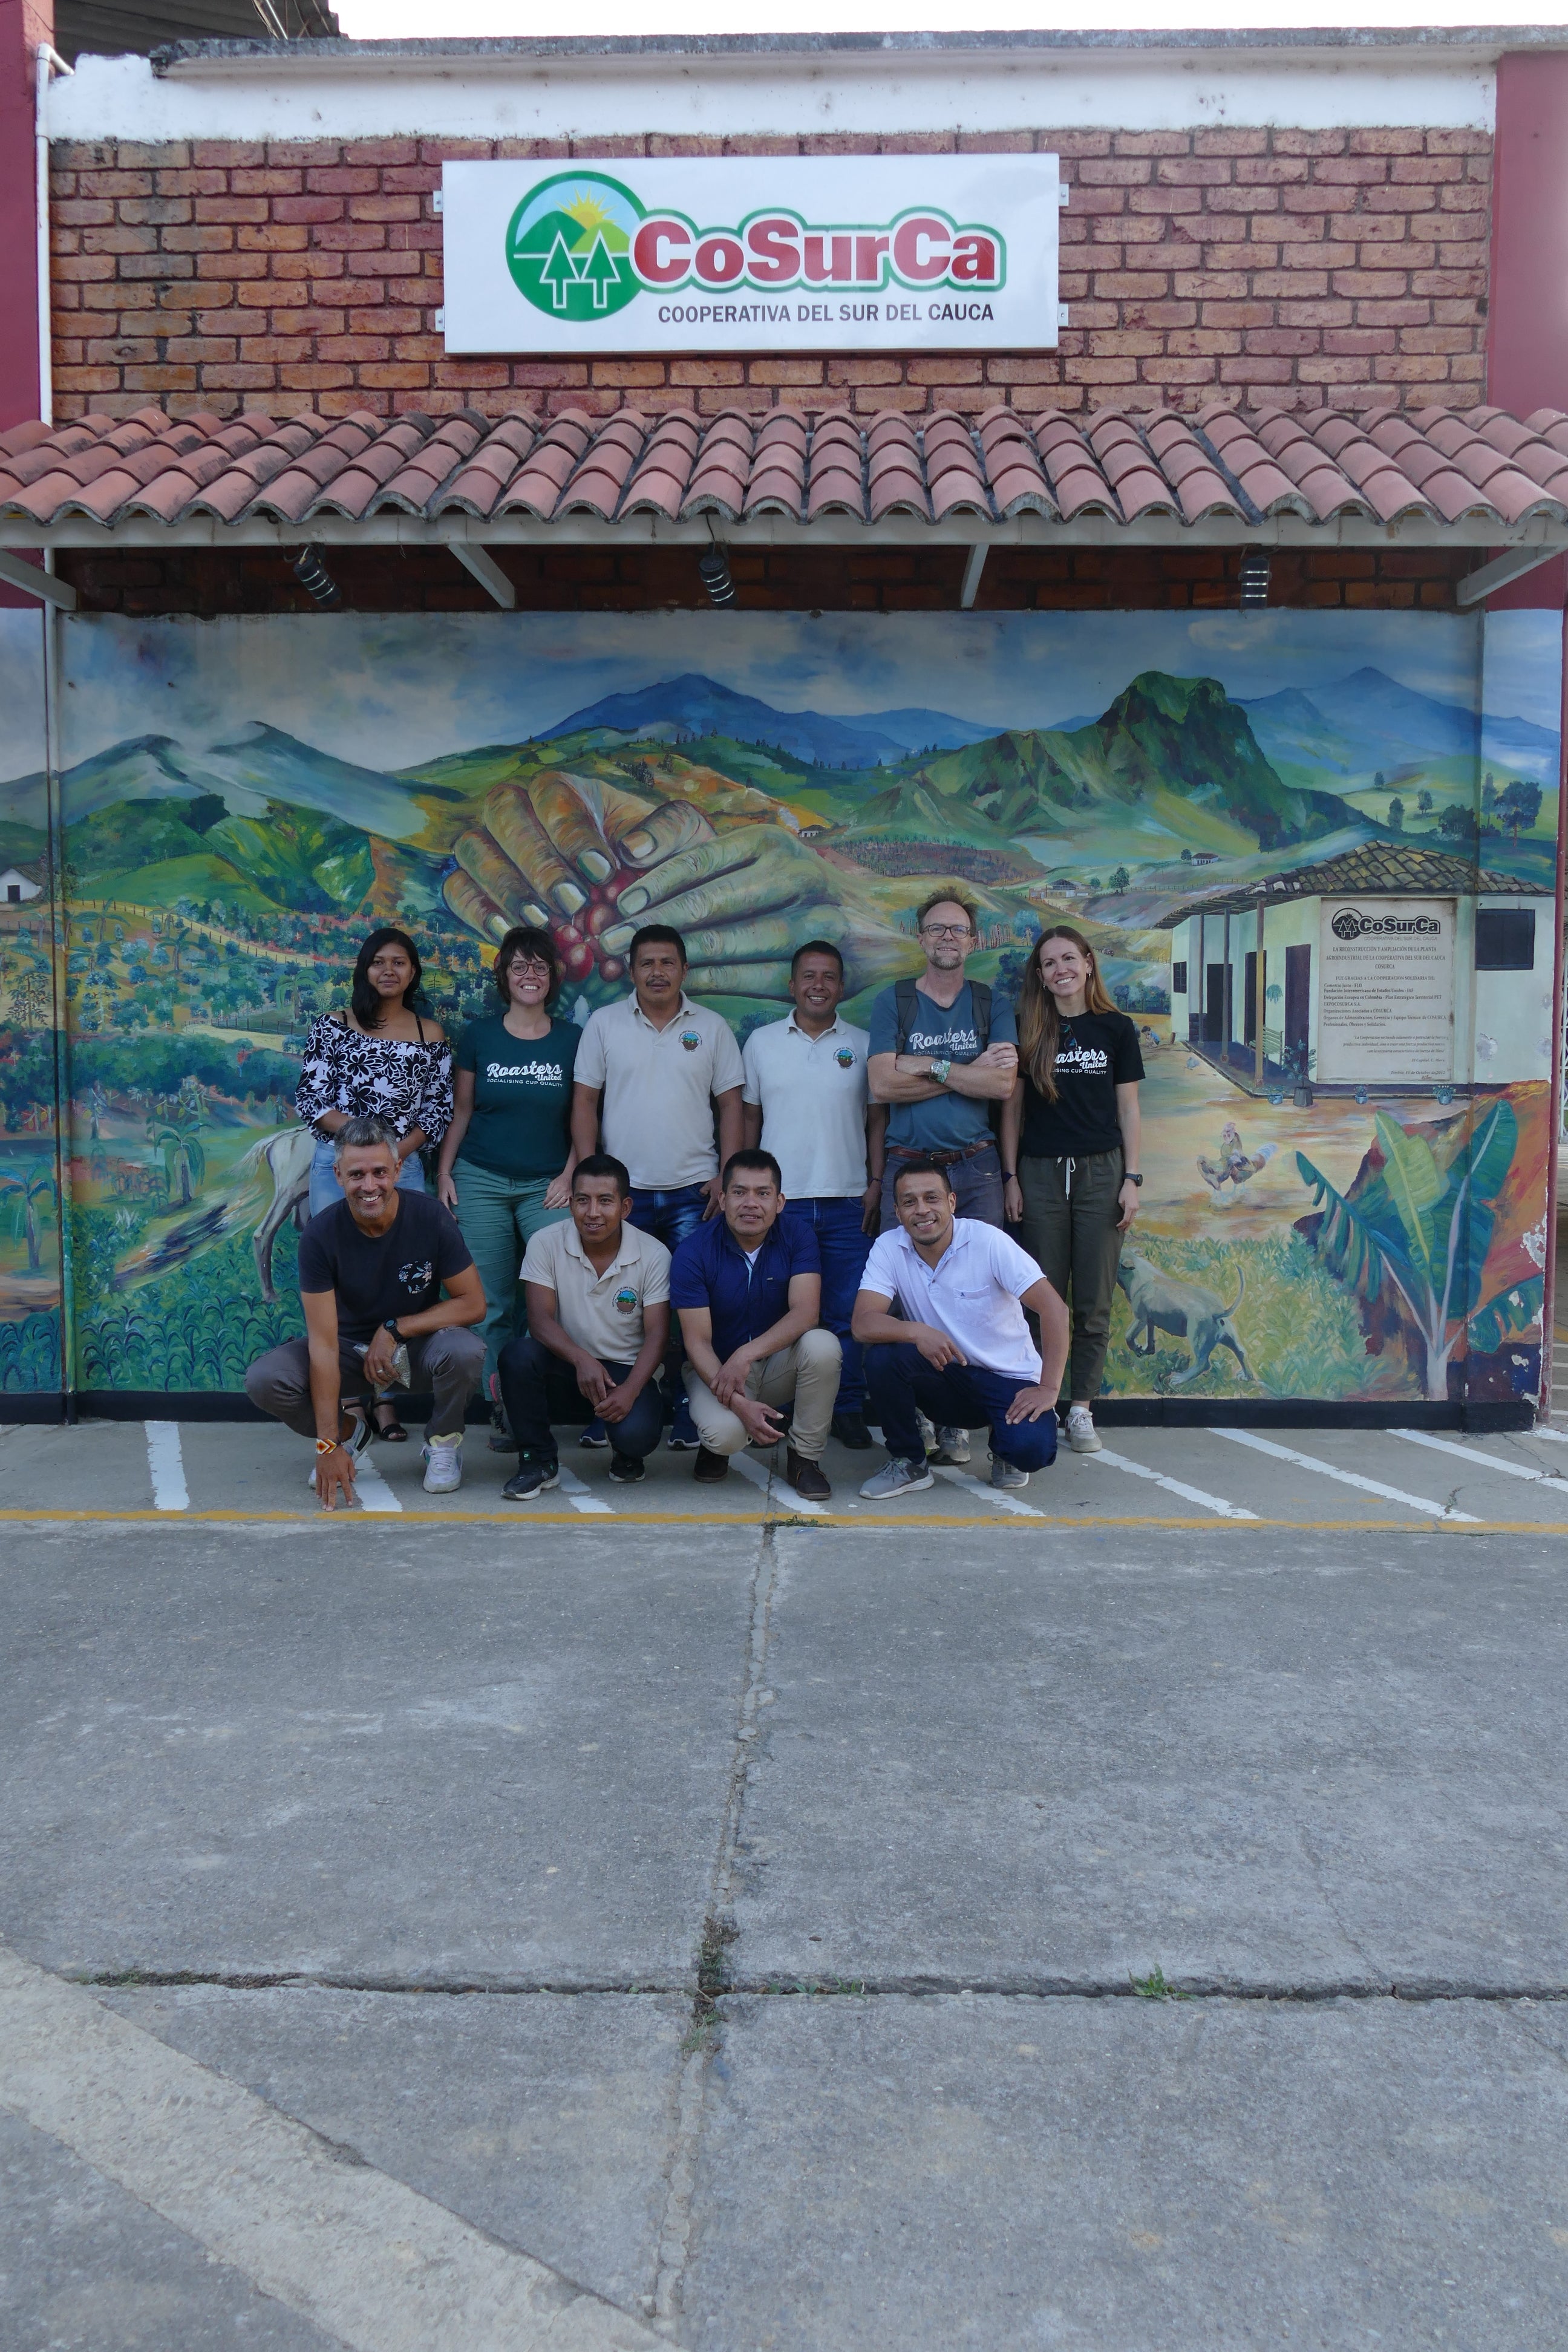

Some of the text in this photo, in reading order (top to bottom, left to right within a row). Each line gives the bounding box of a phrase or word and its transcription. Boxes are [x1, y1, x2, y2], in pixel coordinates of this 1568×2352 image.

[633, 217, 996, 283] CoSurCa
[658, 303, 994, 323] COOPERATIVA DEL SUR DEL CAUCA
[1359, 917, 1439, 932] CoSurCa
[909, 1027, 977, 1050] Roasters
[950, 1040, 978, 1051] United
[1054, 1046, 1108, 1064] asters
[486, 1060, 563, 1078] Roasters
[1079, 1059, 1108, 1070] United
[535, 1073, 563, 1082] United
